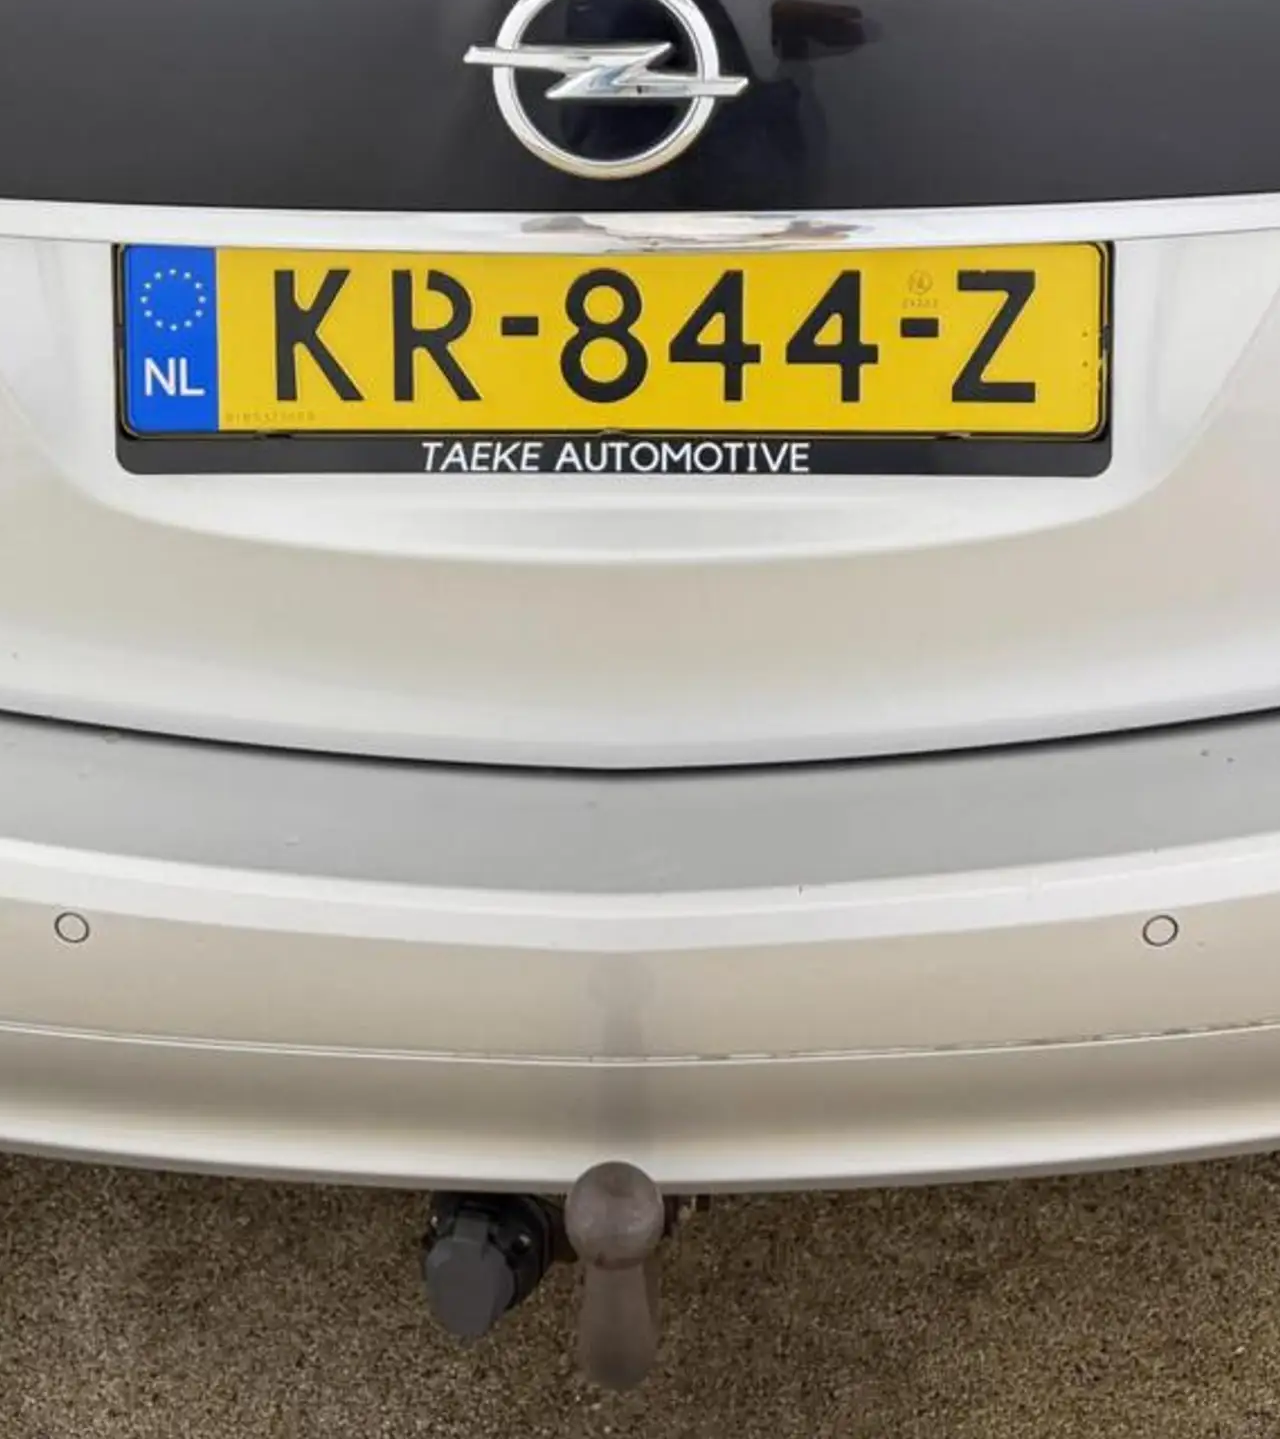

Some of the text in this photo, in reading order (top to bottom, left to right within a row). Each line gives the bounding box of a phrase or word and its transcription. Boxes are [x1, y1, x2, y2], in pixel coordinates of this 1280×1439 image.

[274, 268, 1036, 403] KR-844-Z
[144, 357, 206, 397] NL
[421, 441, 811, 474] TAEKE AUTOMOTIVE
